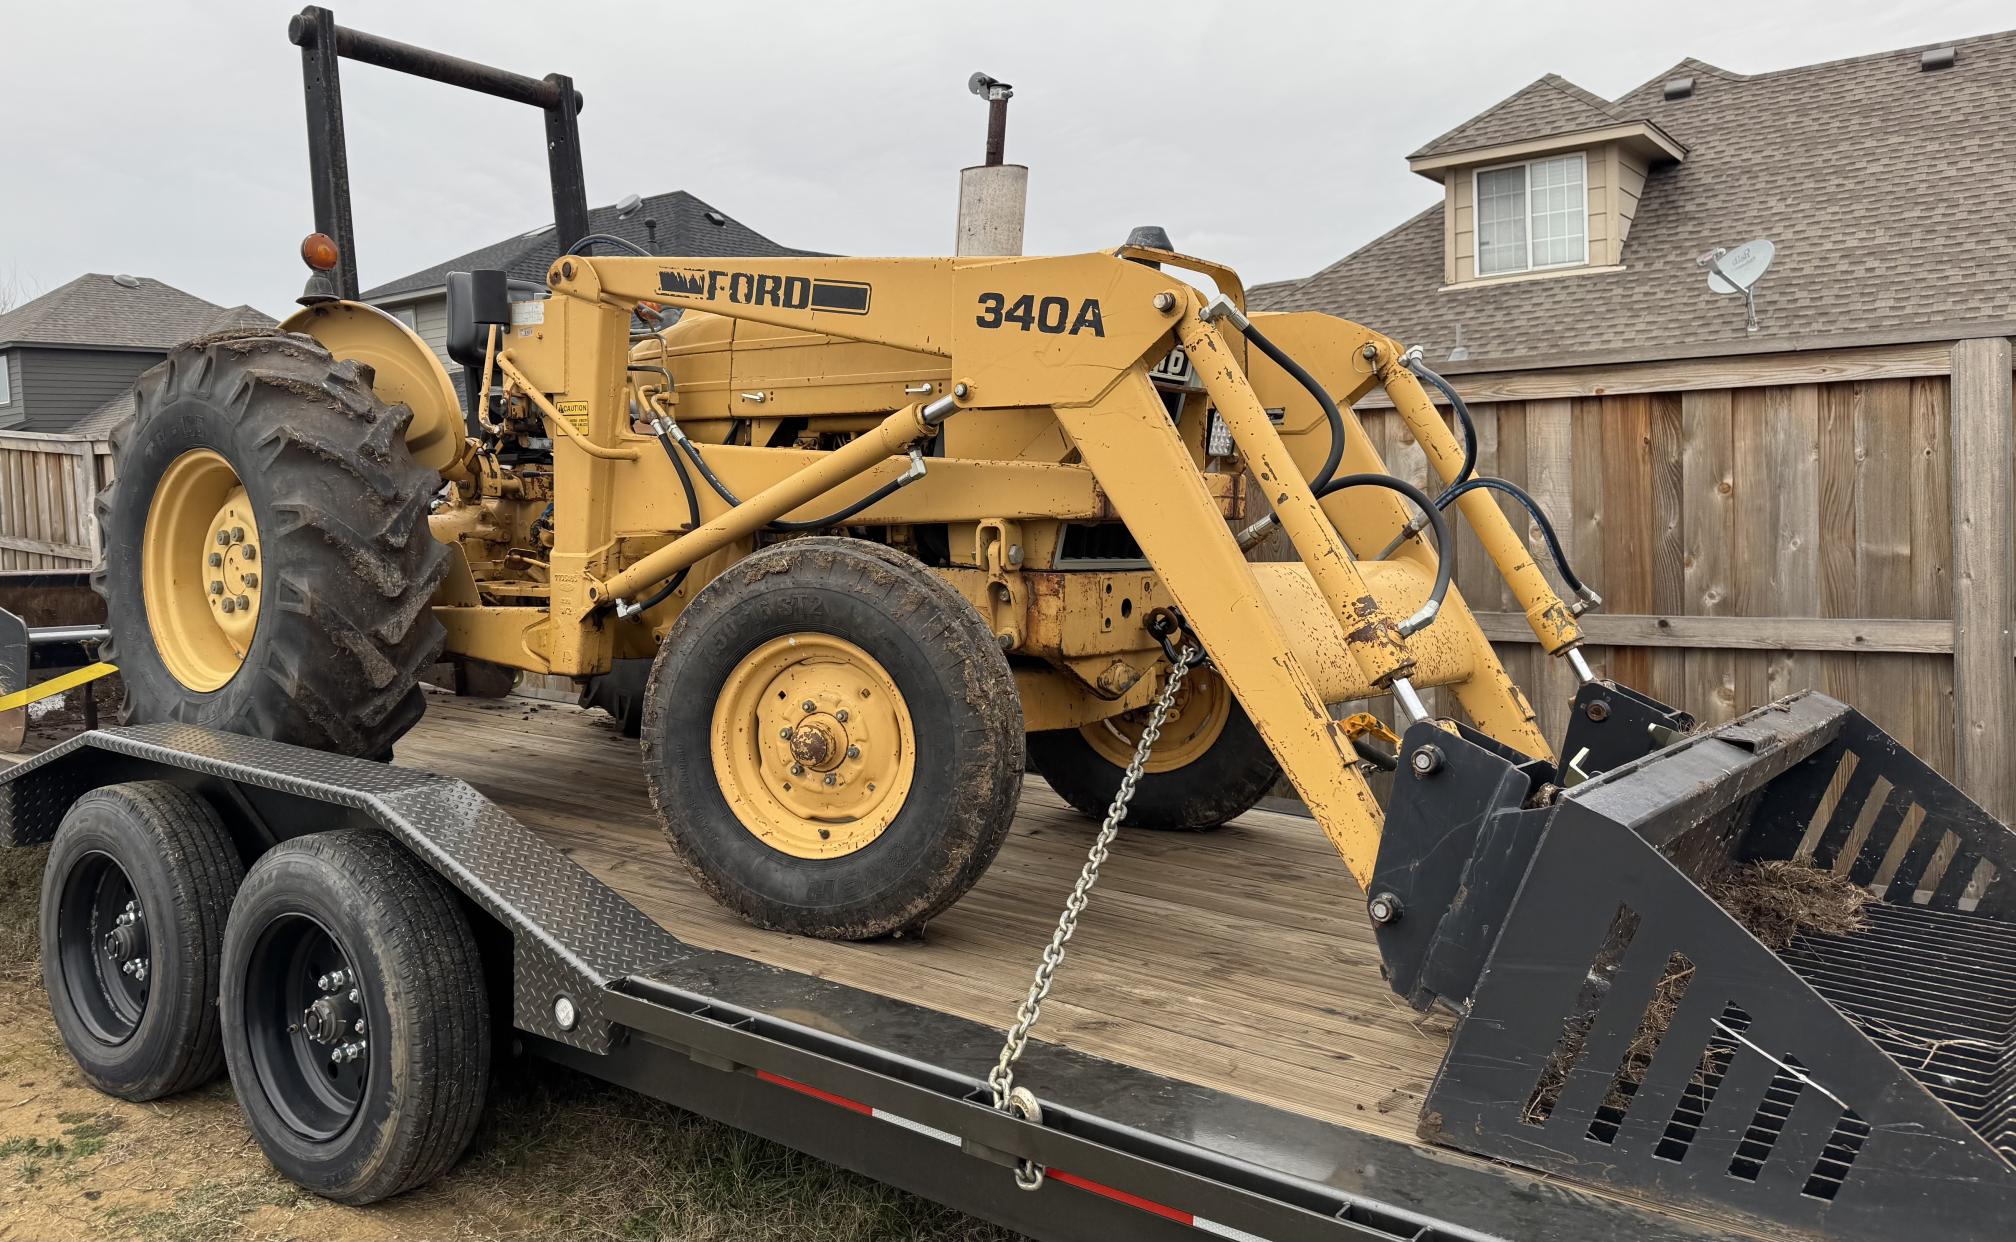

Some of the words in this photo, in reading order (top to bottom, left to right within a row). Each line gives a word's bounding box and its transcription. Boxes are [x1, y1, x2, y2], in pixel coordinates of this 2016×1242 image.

[706, 270, 811, 310] FORD
[976, 292, 1106, 338] 340A
[563, 404, 587, 412] CAUTION
